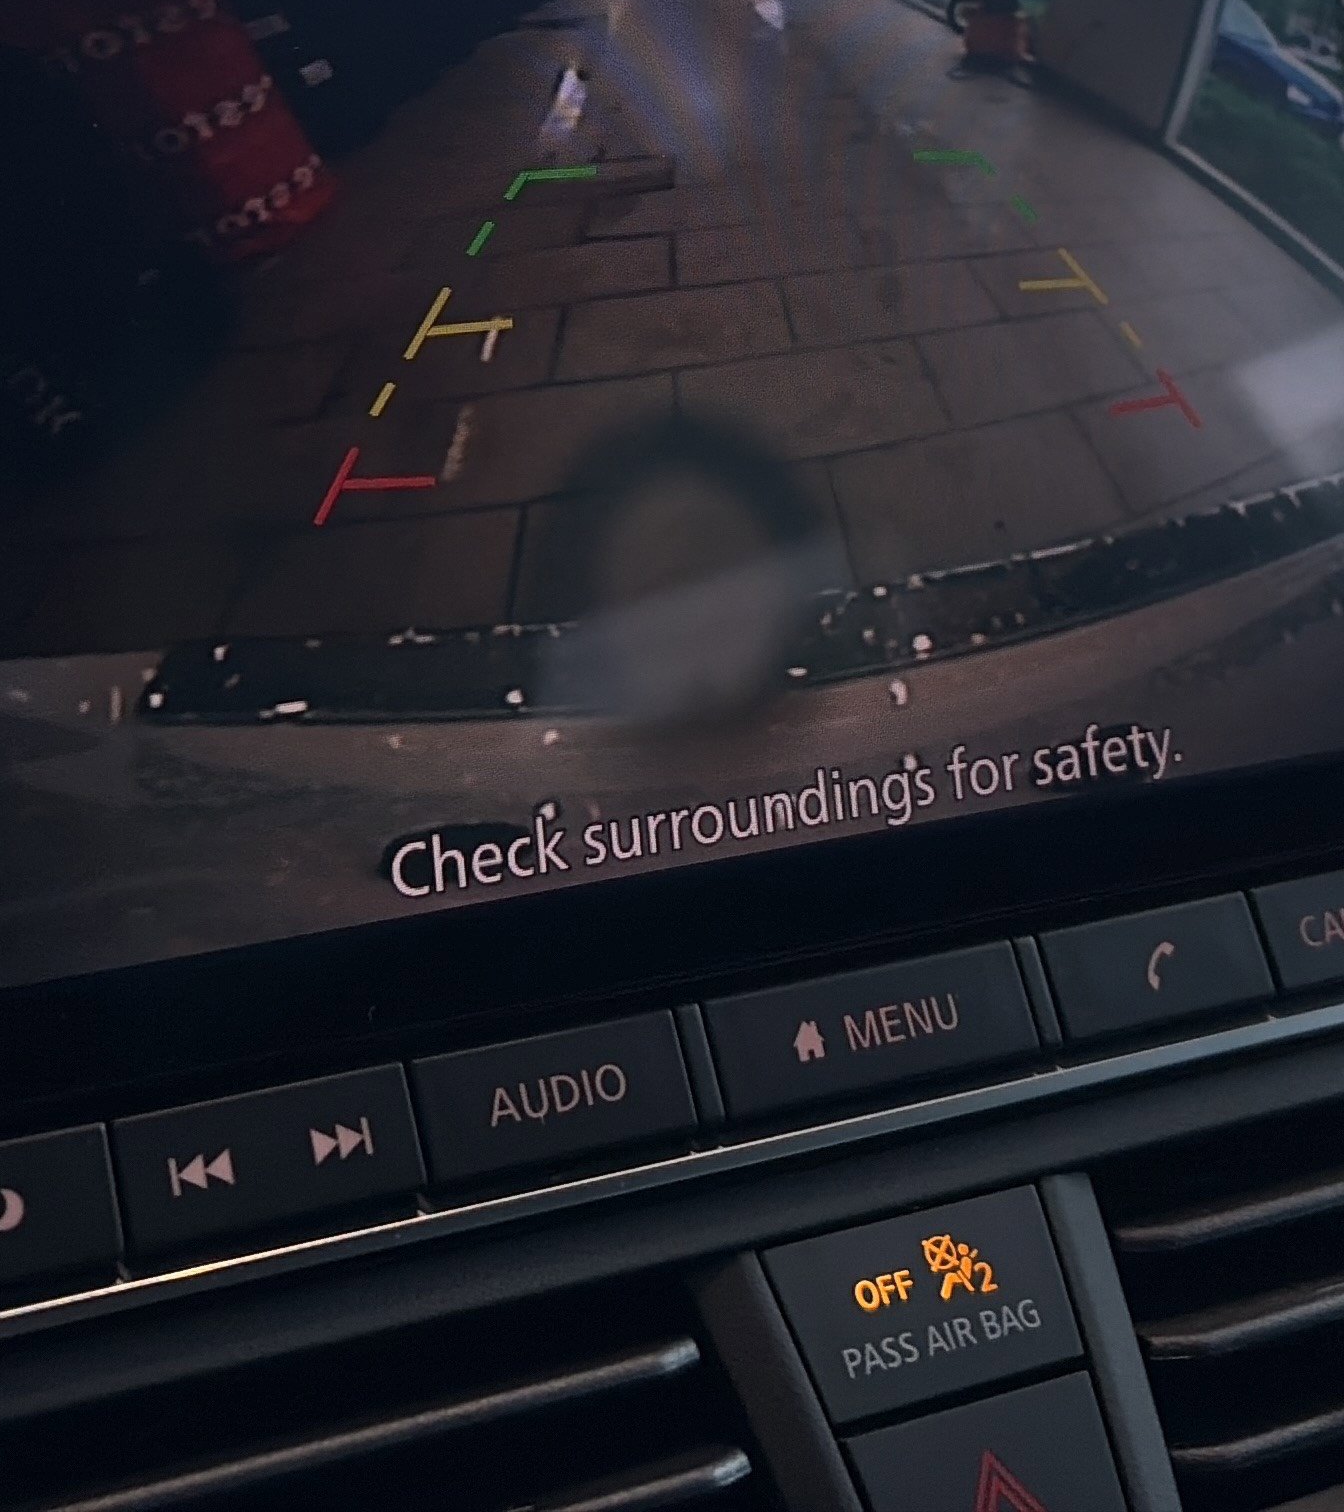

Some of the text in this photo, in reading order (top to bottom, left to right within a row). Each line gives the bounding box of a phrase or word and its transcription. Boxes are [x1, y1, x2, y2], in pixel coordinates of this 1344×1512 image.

[390, 723, 1183, 897] Check surroundings for safety.
[843, 993, 960, 1052] MENU
[490, 1063, 628, 1128] AUDIO
[854, 1270, 913, 1312] OFF
[842, 1299, 1042, 1379] PASS AIR BAG
